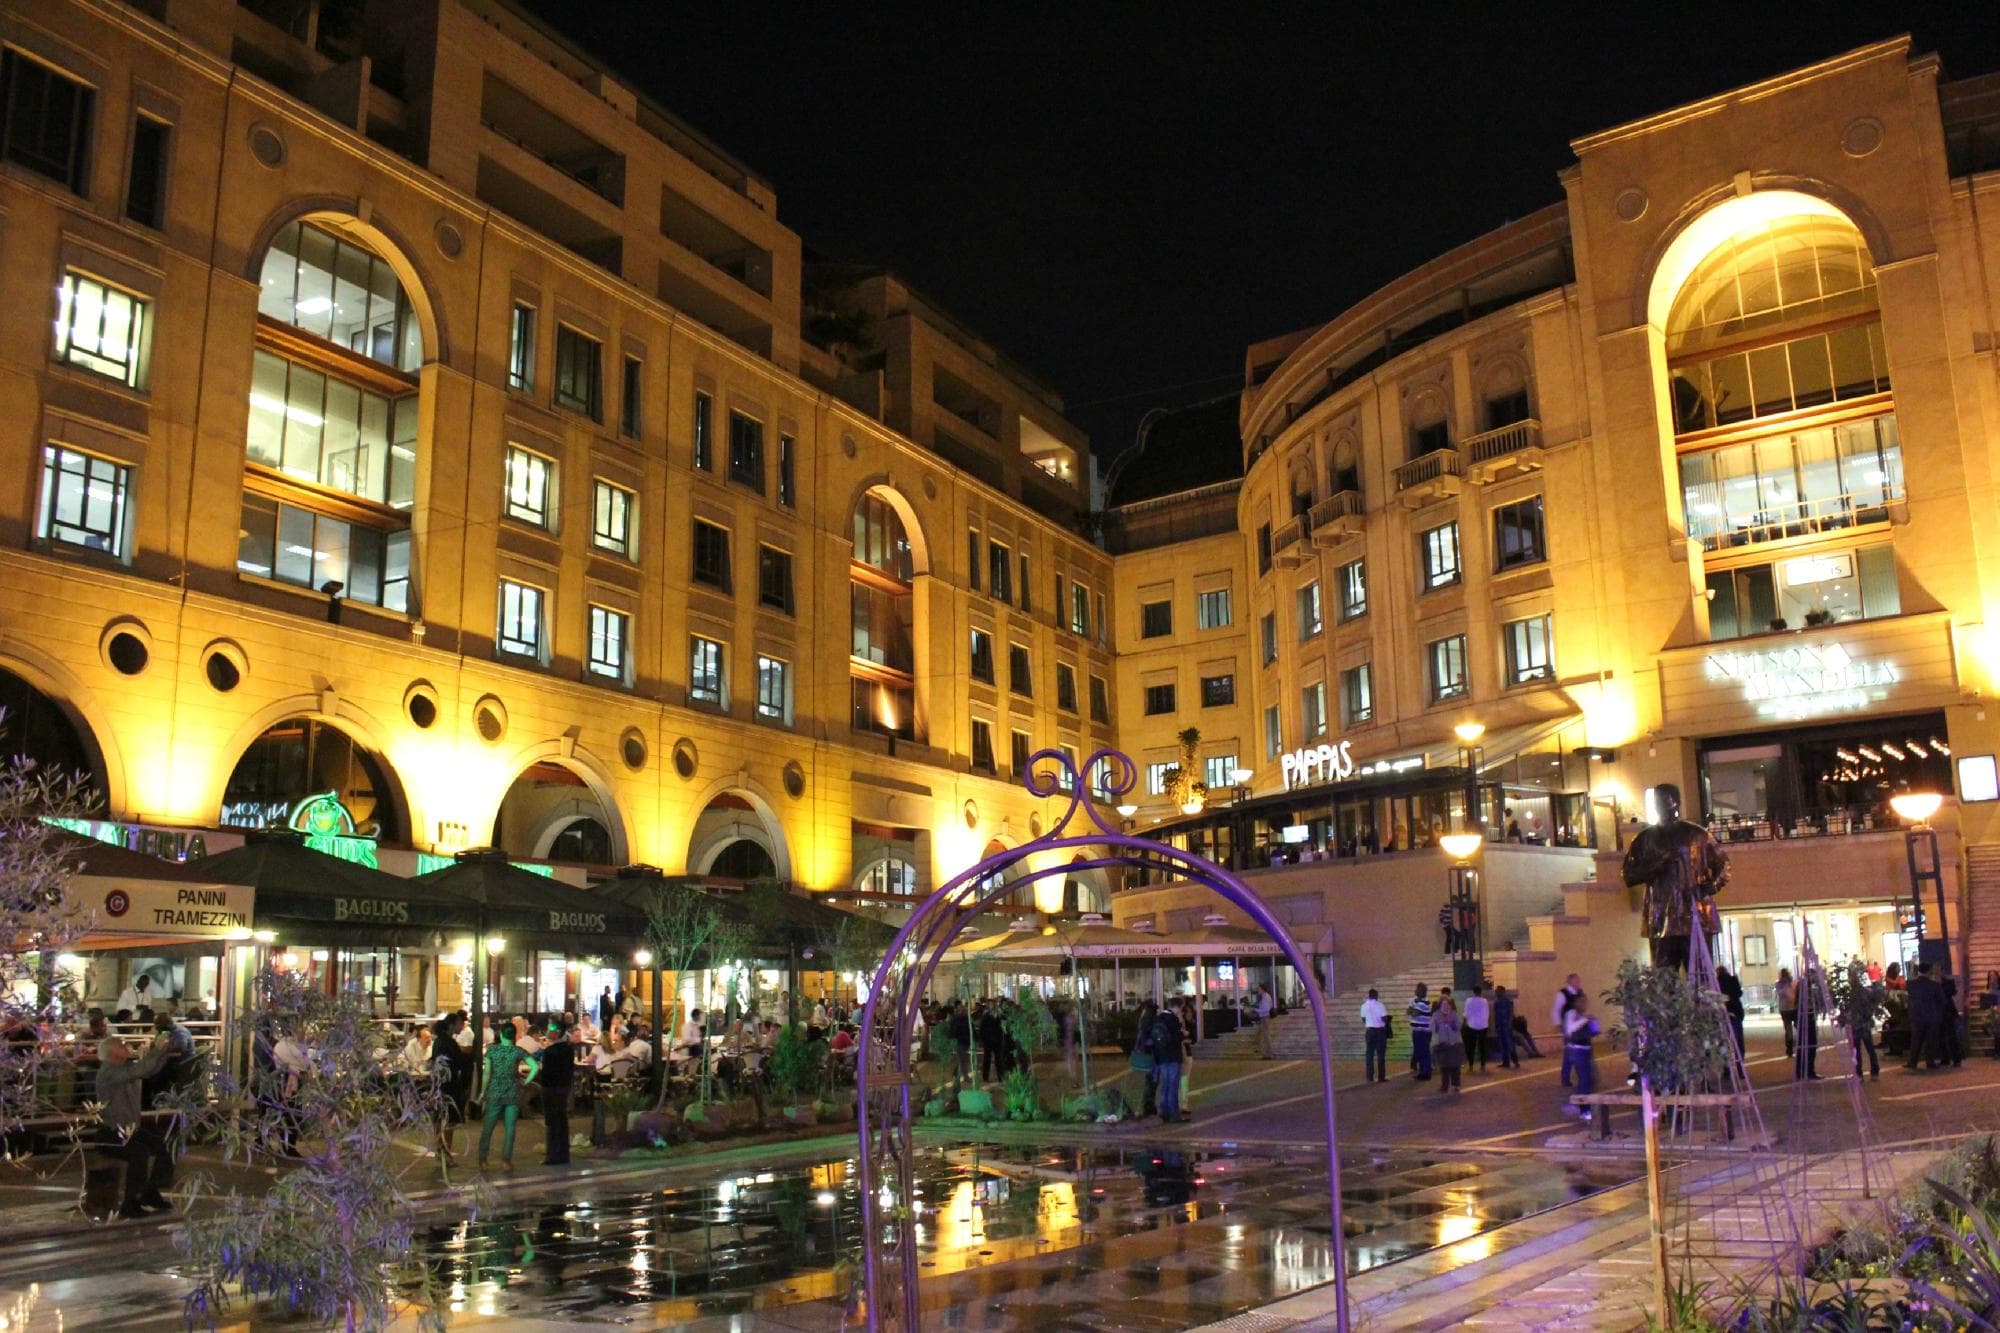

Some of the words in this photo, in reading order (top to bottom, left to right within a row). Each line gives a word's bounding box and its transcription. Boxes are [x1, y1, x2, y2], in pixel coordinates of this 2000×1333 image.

[1281, 740, 1353, 791] PAPPAS
[177, 889, 226, 906] PANINI
[153, 908, 246, 927] TRAMEZZINI
[334, 898, 409, 922] BAGLIOS
[549, 911, 607, 933] BAGLIOS
